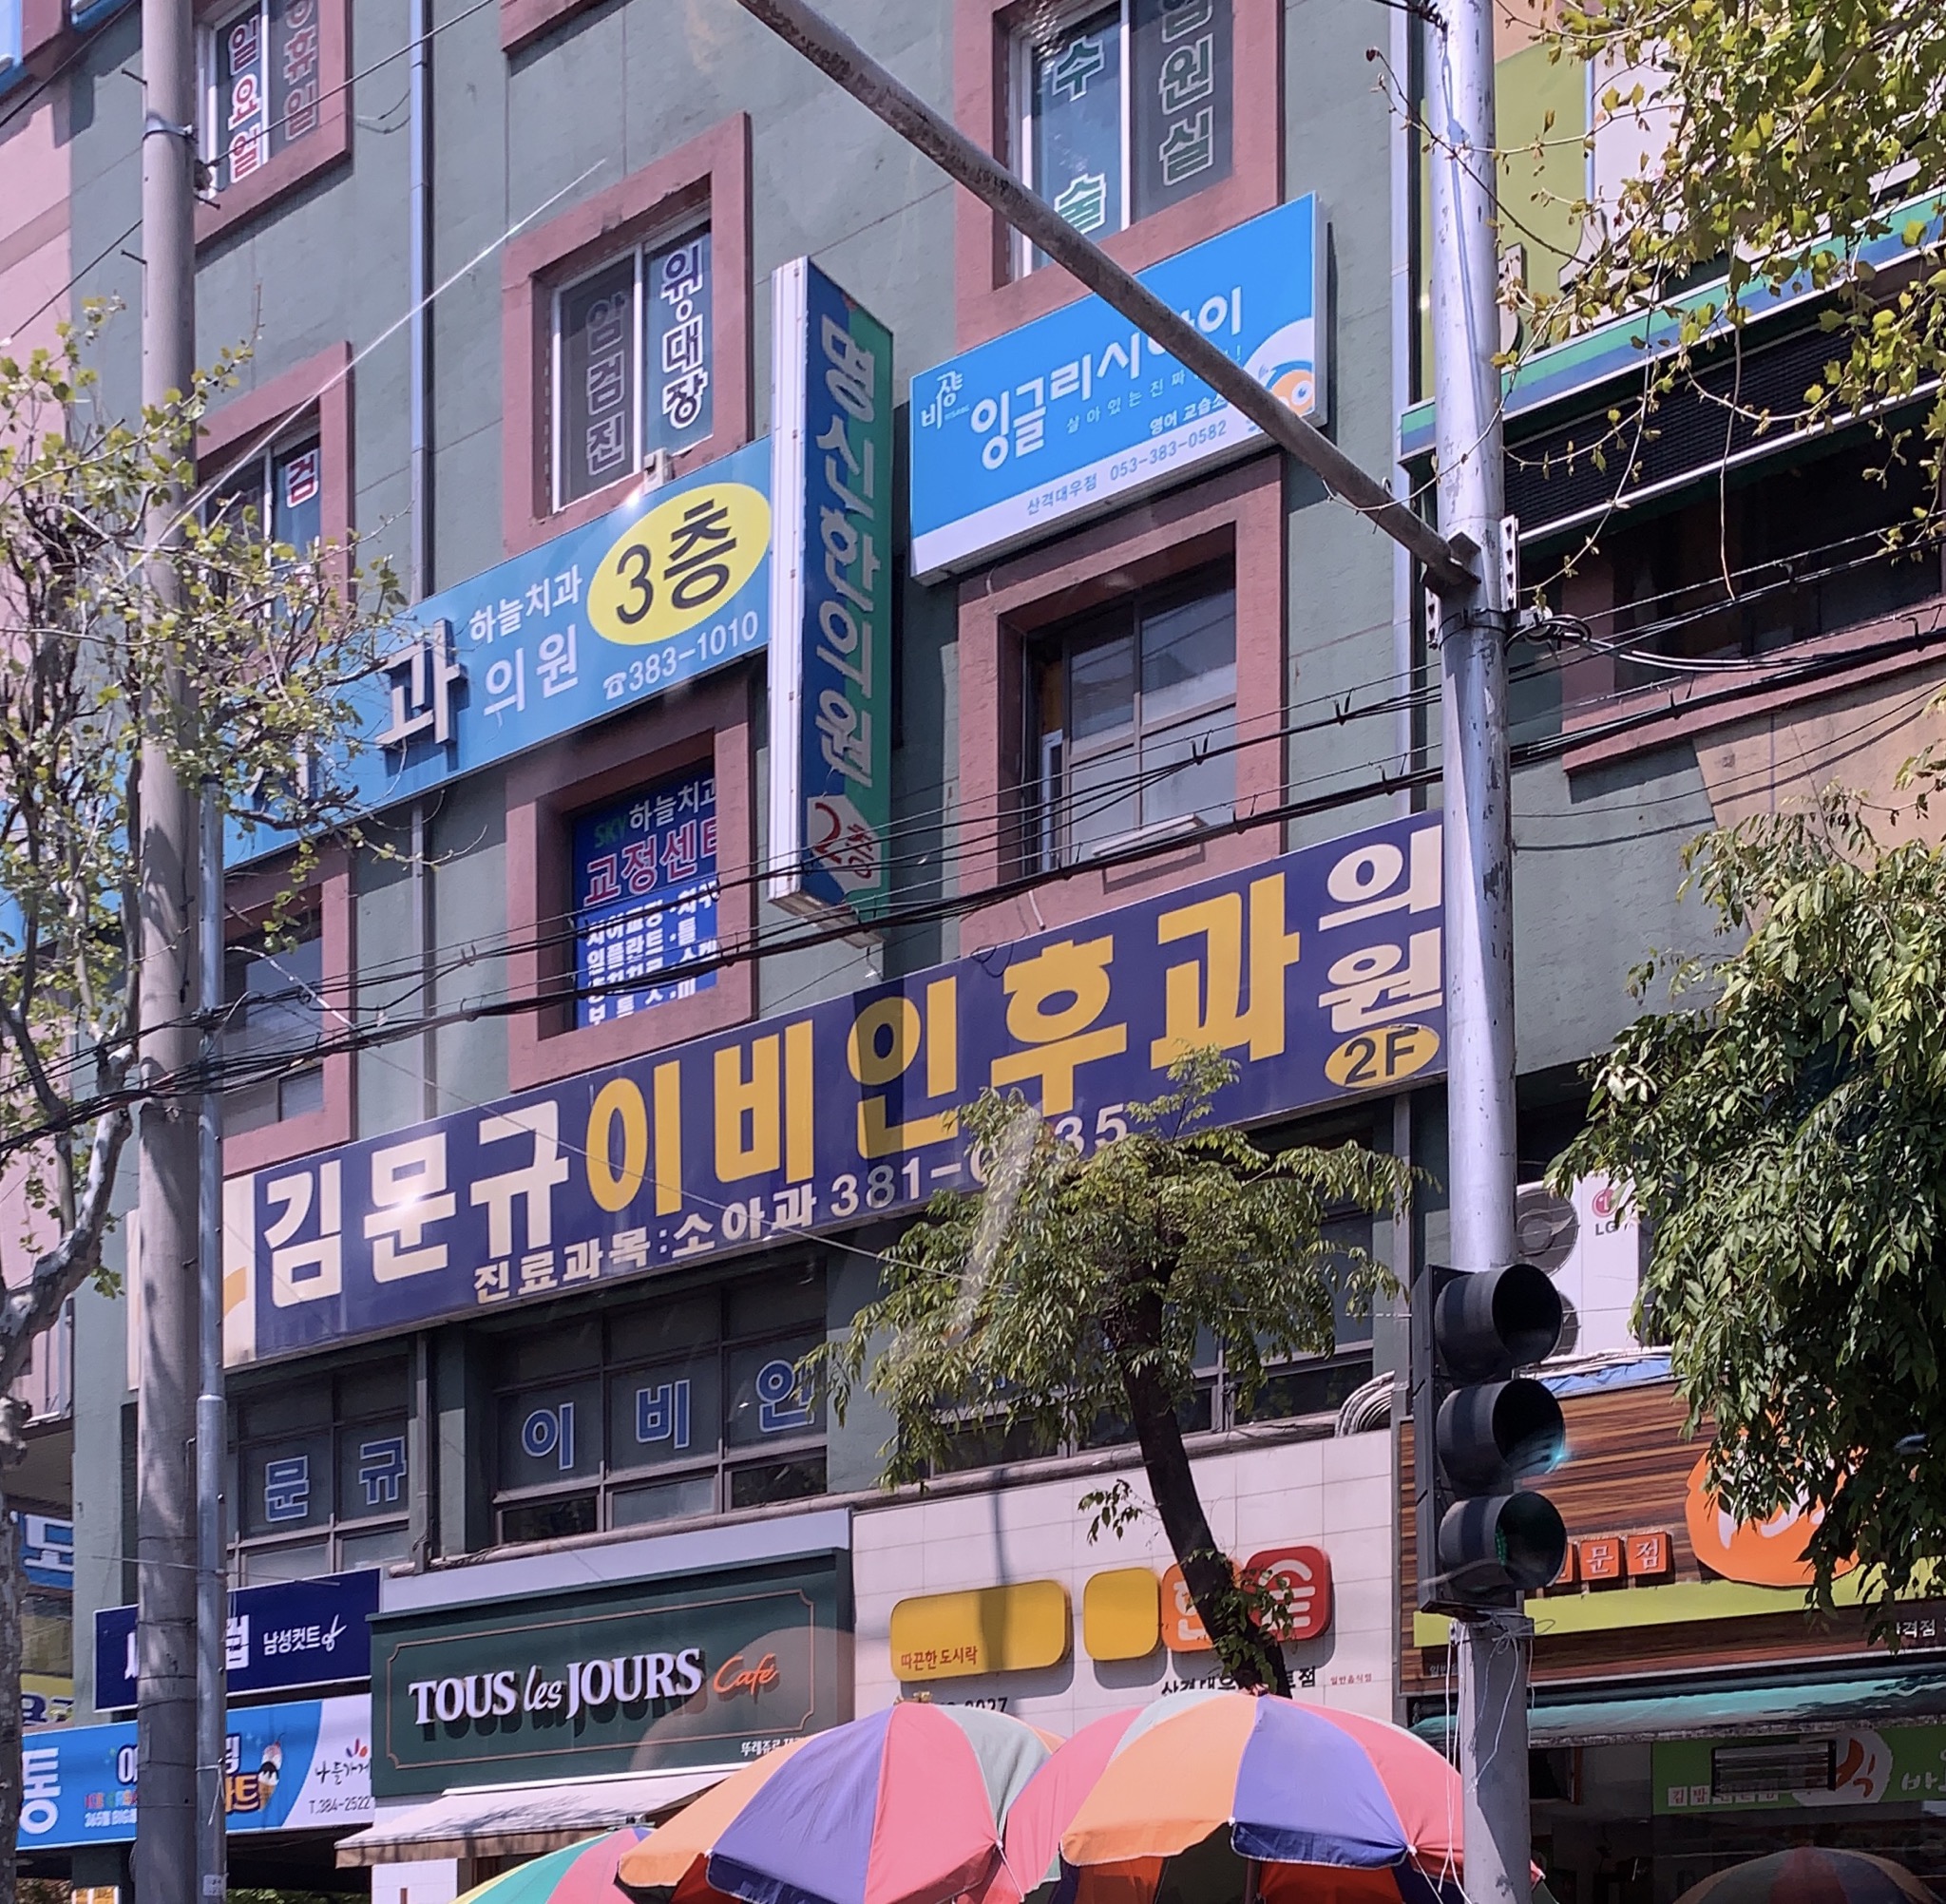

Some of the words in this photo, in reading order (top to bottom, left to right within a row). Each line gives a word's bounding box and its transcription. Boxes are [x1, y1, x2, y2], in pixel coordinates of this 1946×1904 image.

[228, 14, 261, 183] 일요일
[1148, 409, 1179, 436] 영어
[1026, 472, 1098, 517] 산격대우점
[1109, 418, 1229, 482] 053-383-0582
[614, 498, 737, 627] 3층
[815, 313, 876, 789] 명신한의원
[468, 563, 584, 645] 하늘치과
[483, 623, 581, 718] 의원
[628, 609, 759, 695] 383-1010
[1318, 824, 1443, 1034] 의원
[263, 1098, 570, 1309] 김문규
[584, 871, 1301, 1217] 이비인후과
[1344, 1025, 1420, 1086] 2F
[1594, 1221, 1616, 1236] LG
[1560, 1537, 1660, 1578] 문점
[262, 1625, 321, 1657] 남성컷트
[900, 1650, 938, 1672] 따끈한
[939, 1645, 979, 1666] 도시락
[1895, 1618, 1936, 1639] 격점
[408, 1669, 519, 1725] TOUS
[523, 1665, 563, 1712] les
[565, 1647, 704, 1721] JOURS
